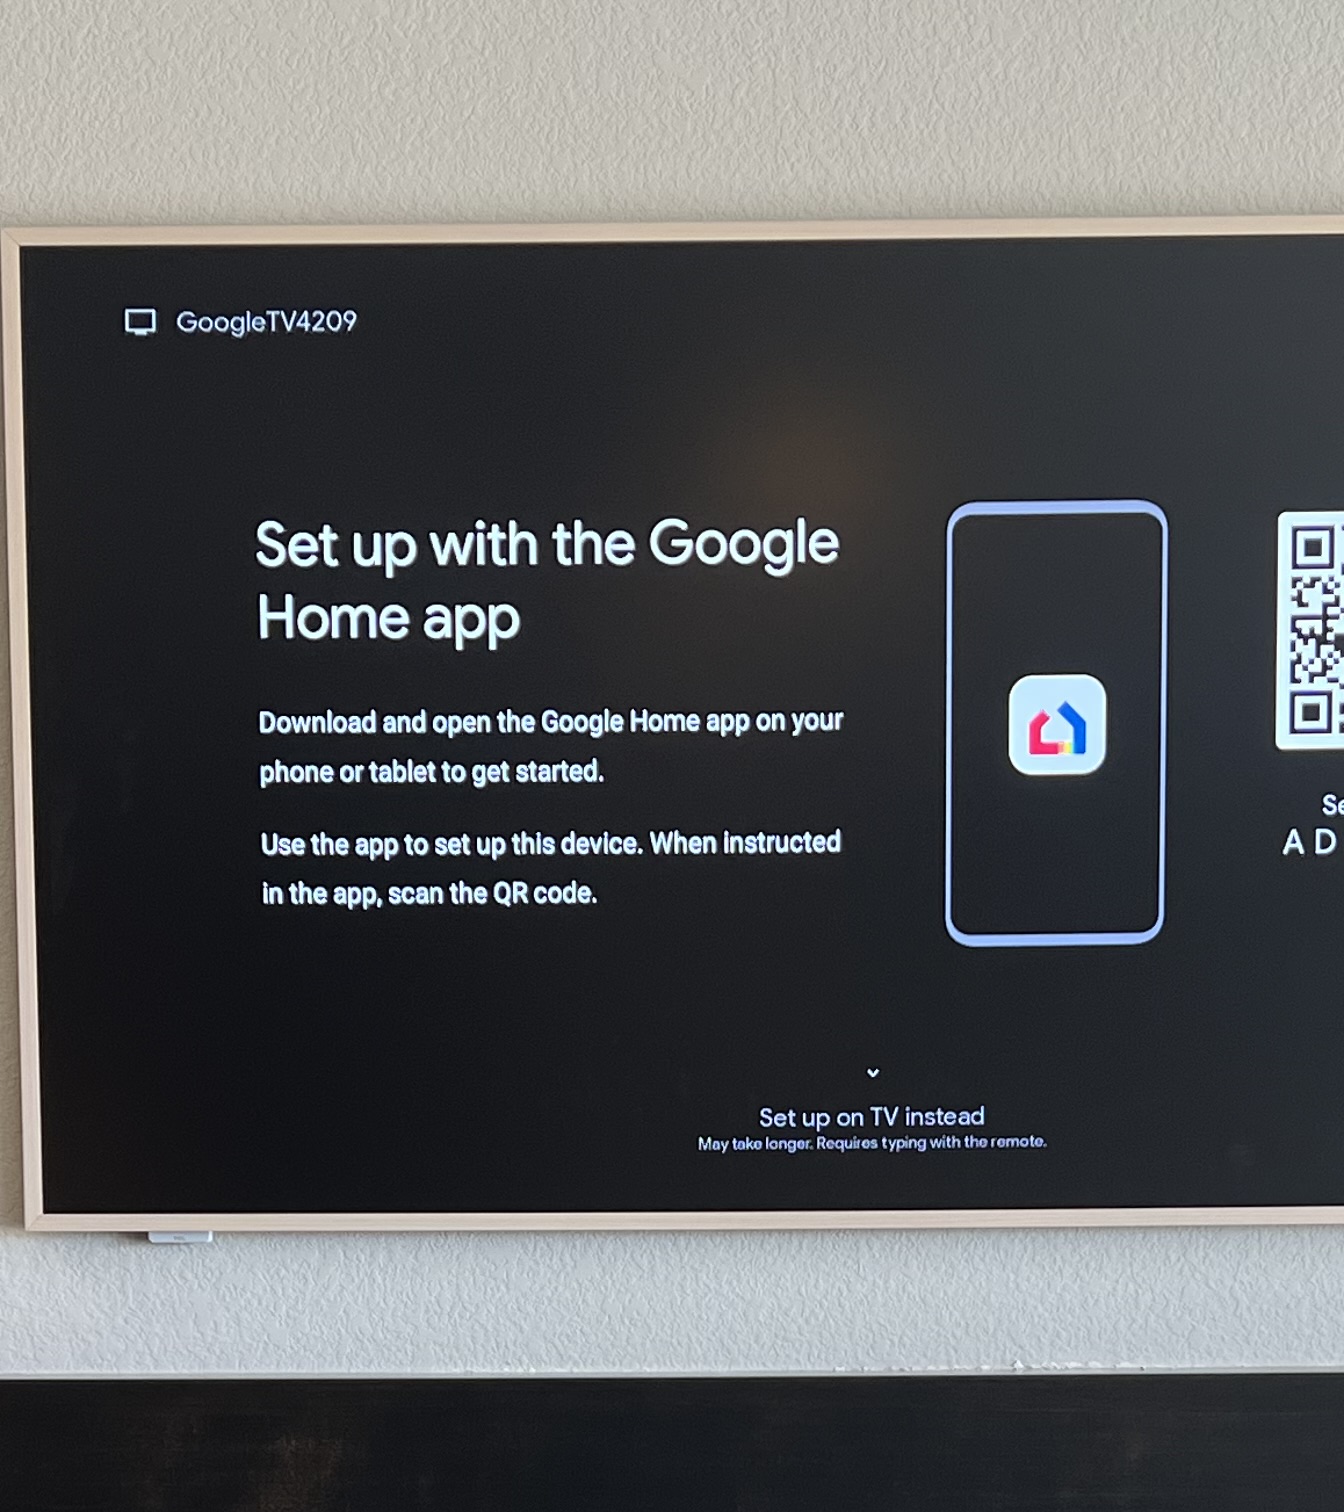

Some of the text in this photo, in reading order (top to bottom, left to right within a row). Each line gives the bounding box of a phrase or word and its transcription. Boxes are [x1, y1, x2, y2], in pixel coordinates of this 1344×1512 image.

[176, 309, 358, 339] GoogleTV4209
[255, 517, 840, 579] Set up with the Google
[259, 593, 521, 652] Home app
[259, 707, 845, 739] Download and open the Google Home app on your
[260, 757, 605, 789] phone or tablet to get started.
[260, 828, 842, 862] Use the app to set up this device. When instructed
[262, 879, 598, 911] in the app, scan the QR code.
[759, 1105, 985, 1132] Set up on TV instead
[698, 1134, 1048, 1154] May take longer. Requires typing with the remote.
